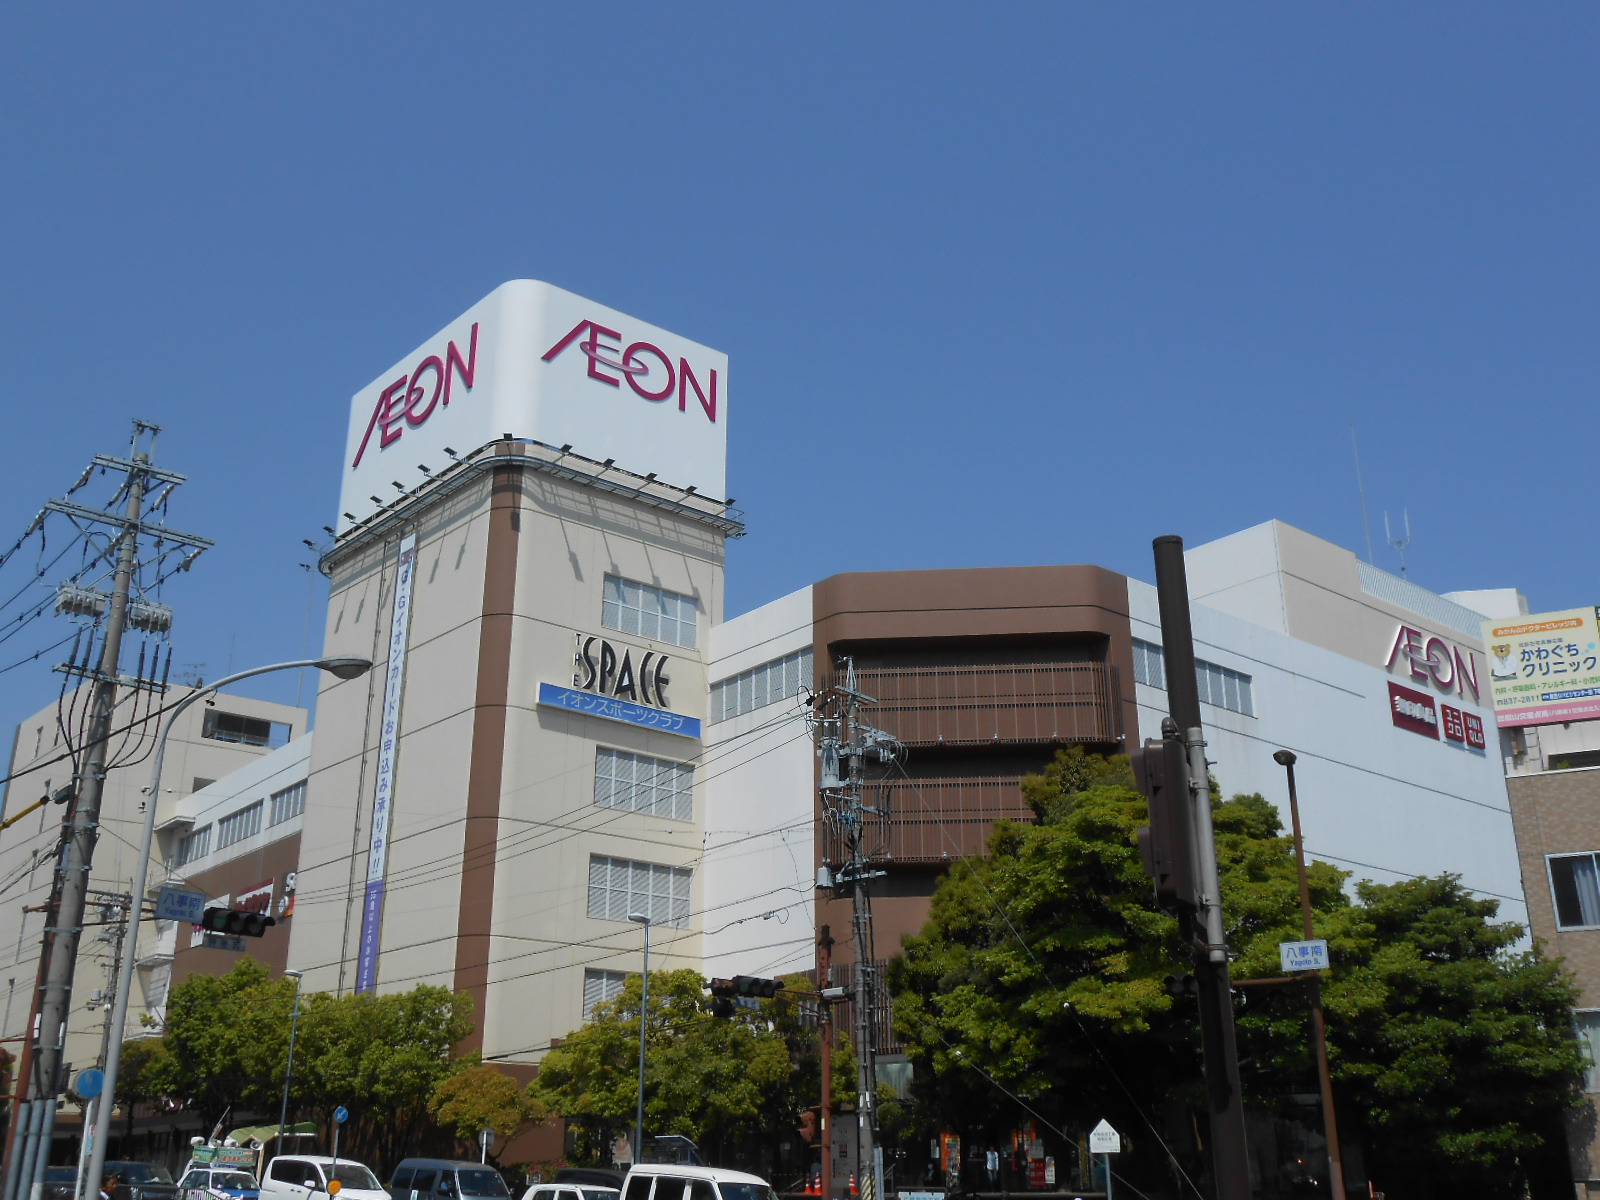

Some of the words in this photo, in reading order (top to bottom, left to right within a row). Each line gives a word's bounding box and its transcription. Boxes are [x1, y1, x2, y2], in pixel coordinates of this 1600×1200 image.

[1520, 643, 1580, 662] かわぐち
[581, 636, 670, 708] SPACE
[1522, 656, 1597, 678] クリニック
[557, 690, 685, 731] イオンスポーツクラブ
[163, 893, 201, 911] 八事南
[1286, 945, 1323, 959] 八事南
[1290, 959, 1312, 967] Yagoto
